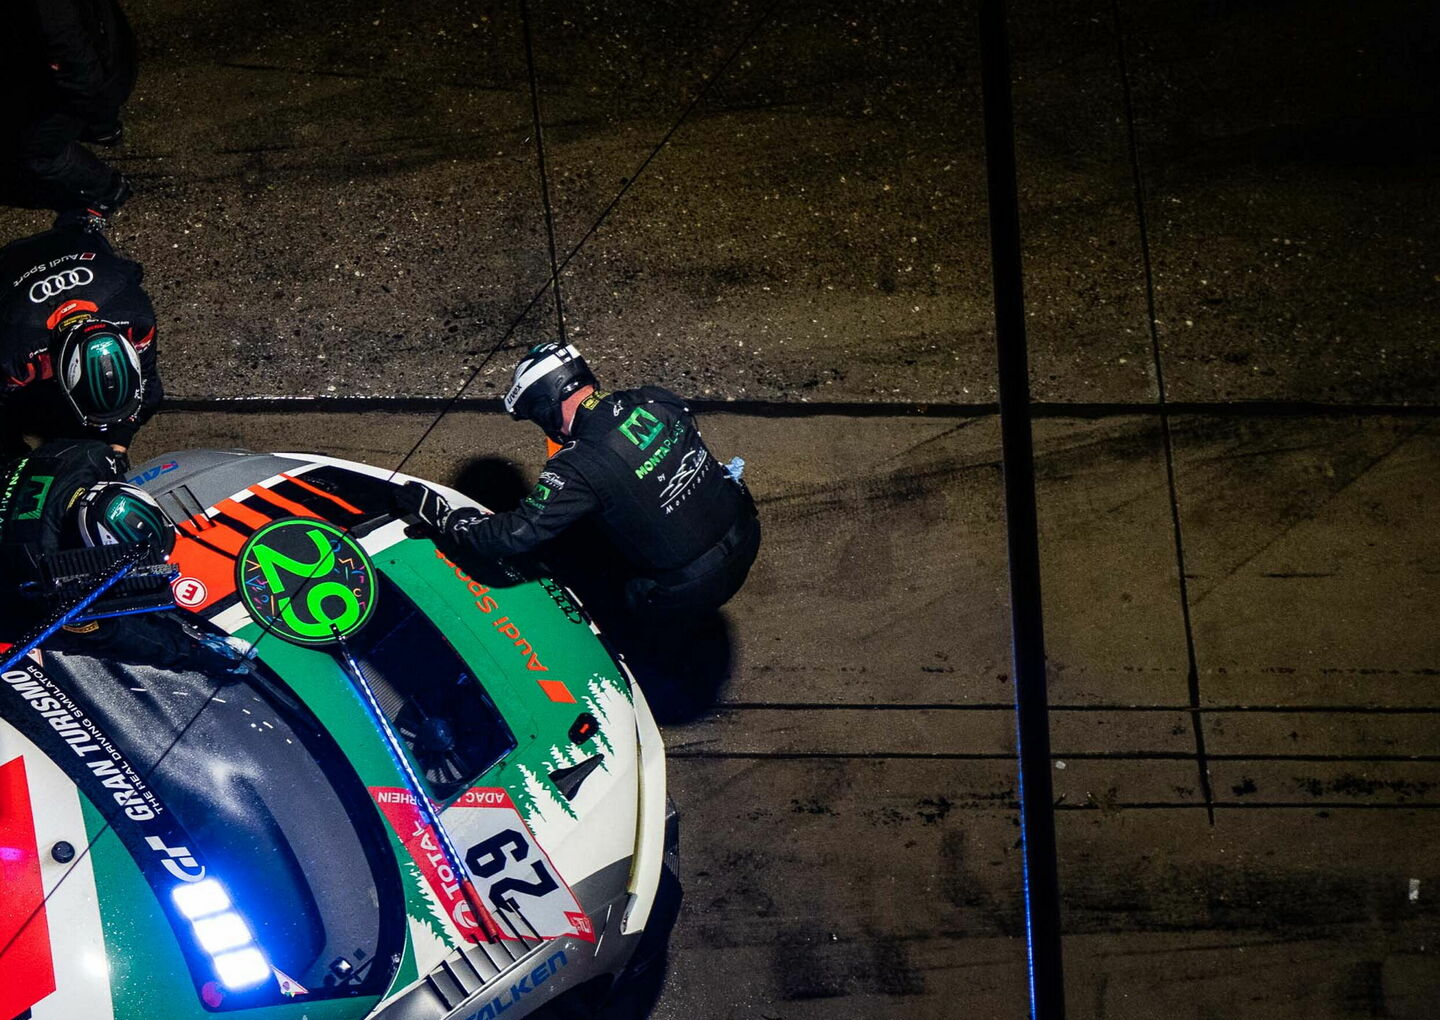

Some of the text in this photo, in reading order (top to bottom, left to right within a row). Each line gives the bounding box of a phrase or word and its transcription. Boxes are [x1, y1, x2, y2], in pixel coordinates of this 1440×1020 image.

[13, 253, 78, 288] Audi Sport
[506, 384, 523, 404] uvex
[657, 472, 666, 482] by
[182, 583, 199, 601] E
[252, 529, 360, 637] 29
[492, 616, 549, 672] Audi
[1, 670, 101, 757] TURISMO
[27, 665, 164, 815] THE REAL DRIVING SIMULATOR
[86, 759, 155, 821] GRAN
[465, 790, 505, 803] ADAC
[412, 819, 460, 900] TOTAL
[465, 828, 560, 914] 29
